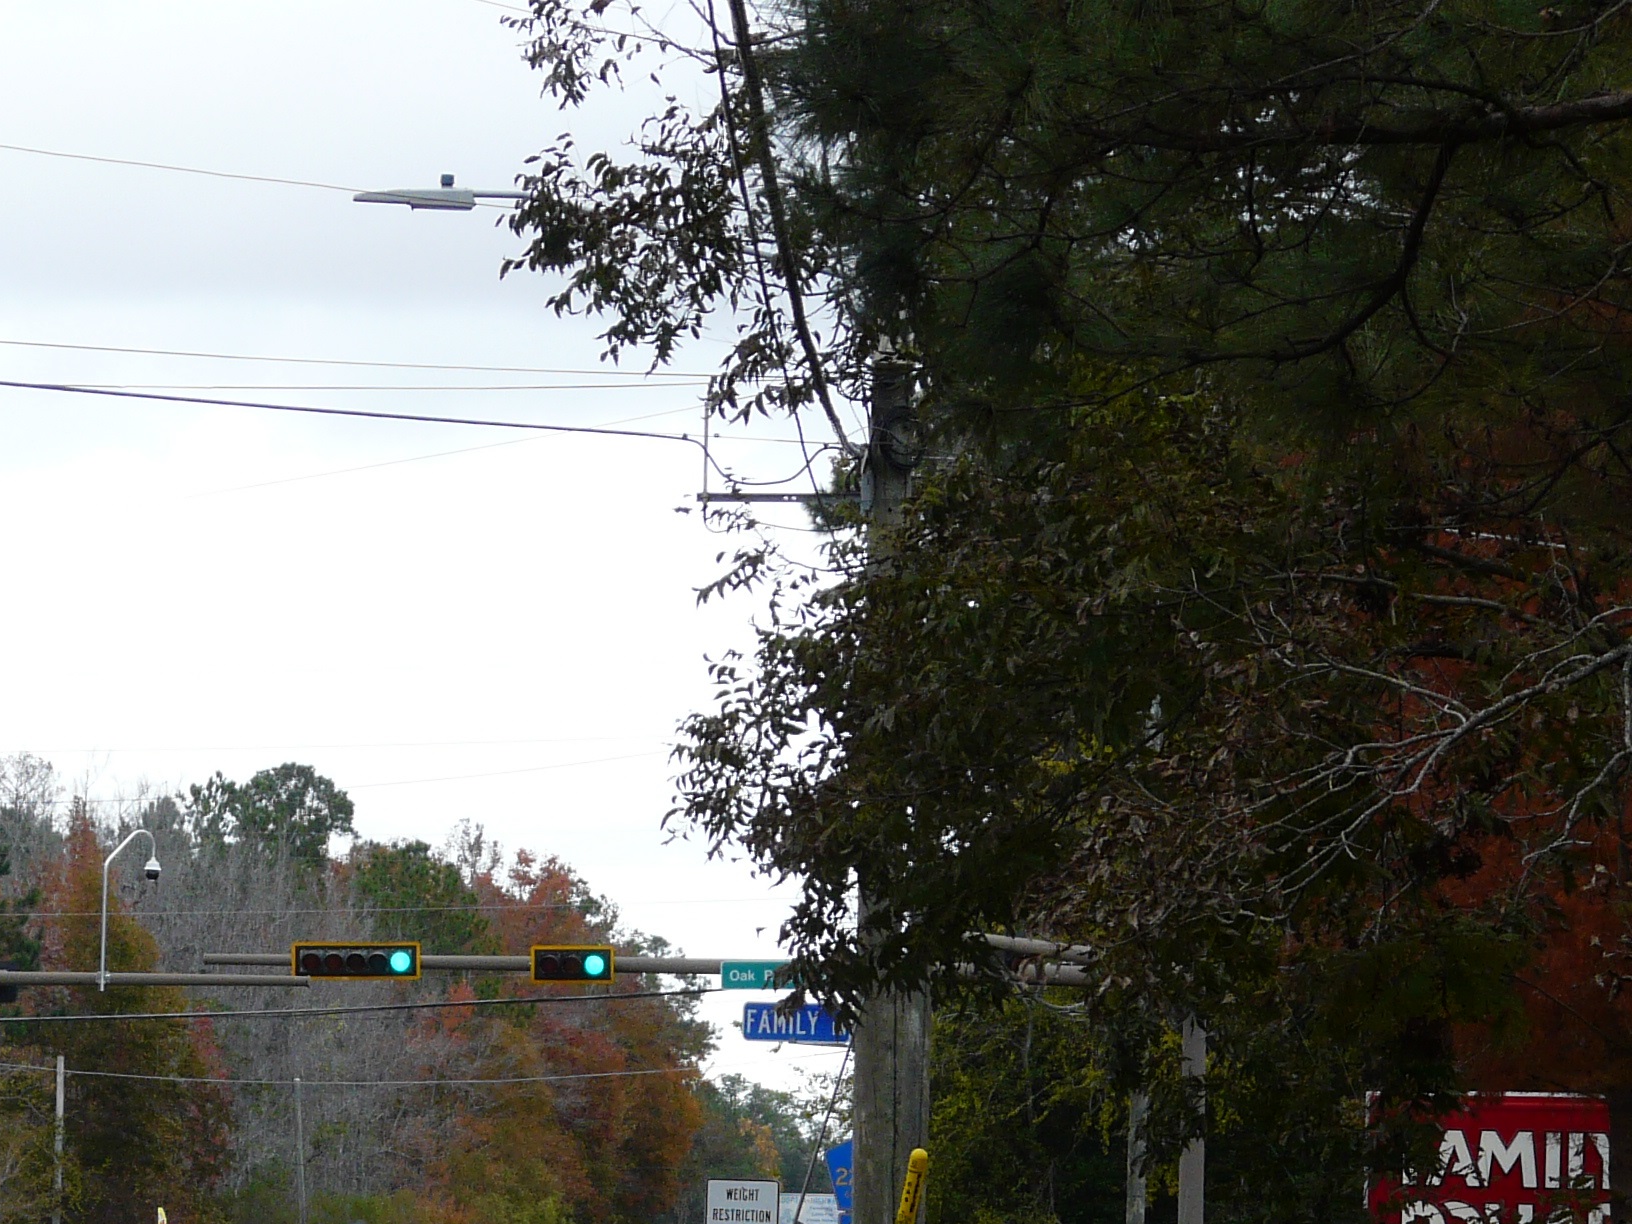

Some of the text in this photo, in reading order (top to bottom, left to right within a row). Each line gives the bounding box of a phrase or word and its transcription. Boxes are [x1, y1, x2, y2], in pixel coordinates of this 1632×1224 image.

[729, 969, 755, 981] Oak
[746, 1009, 819, 1035] FAMILY
[1402, 1129, 1611, 1190] AMILY
[726, 1188, 760, 1201] WEIGHT
[712, 1208, 771, 1222] RESTRICTION
